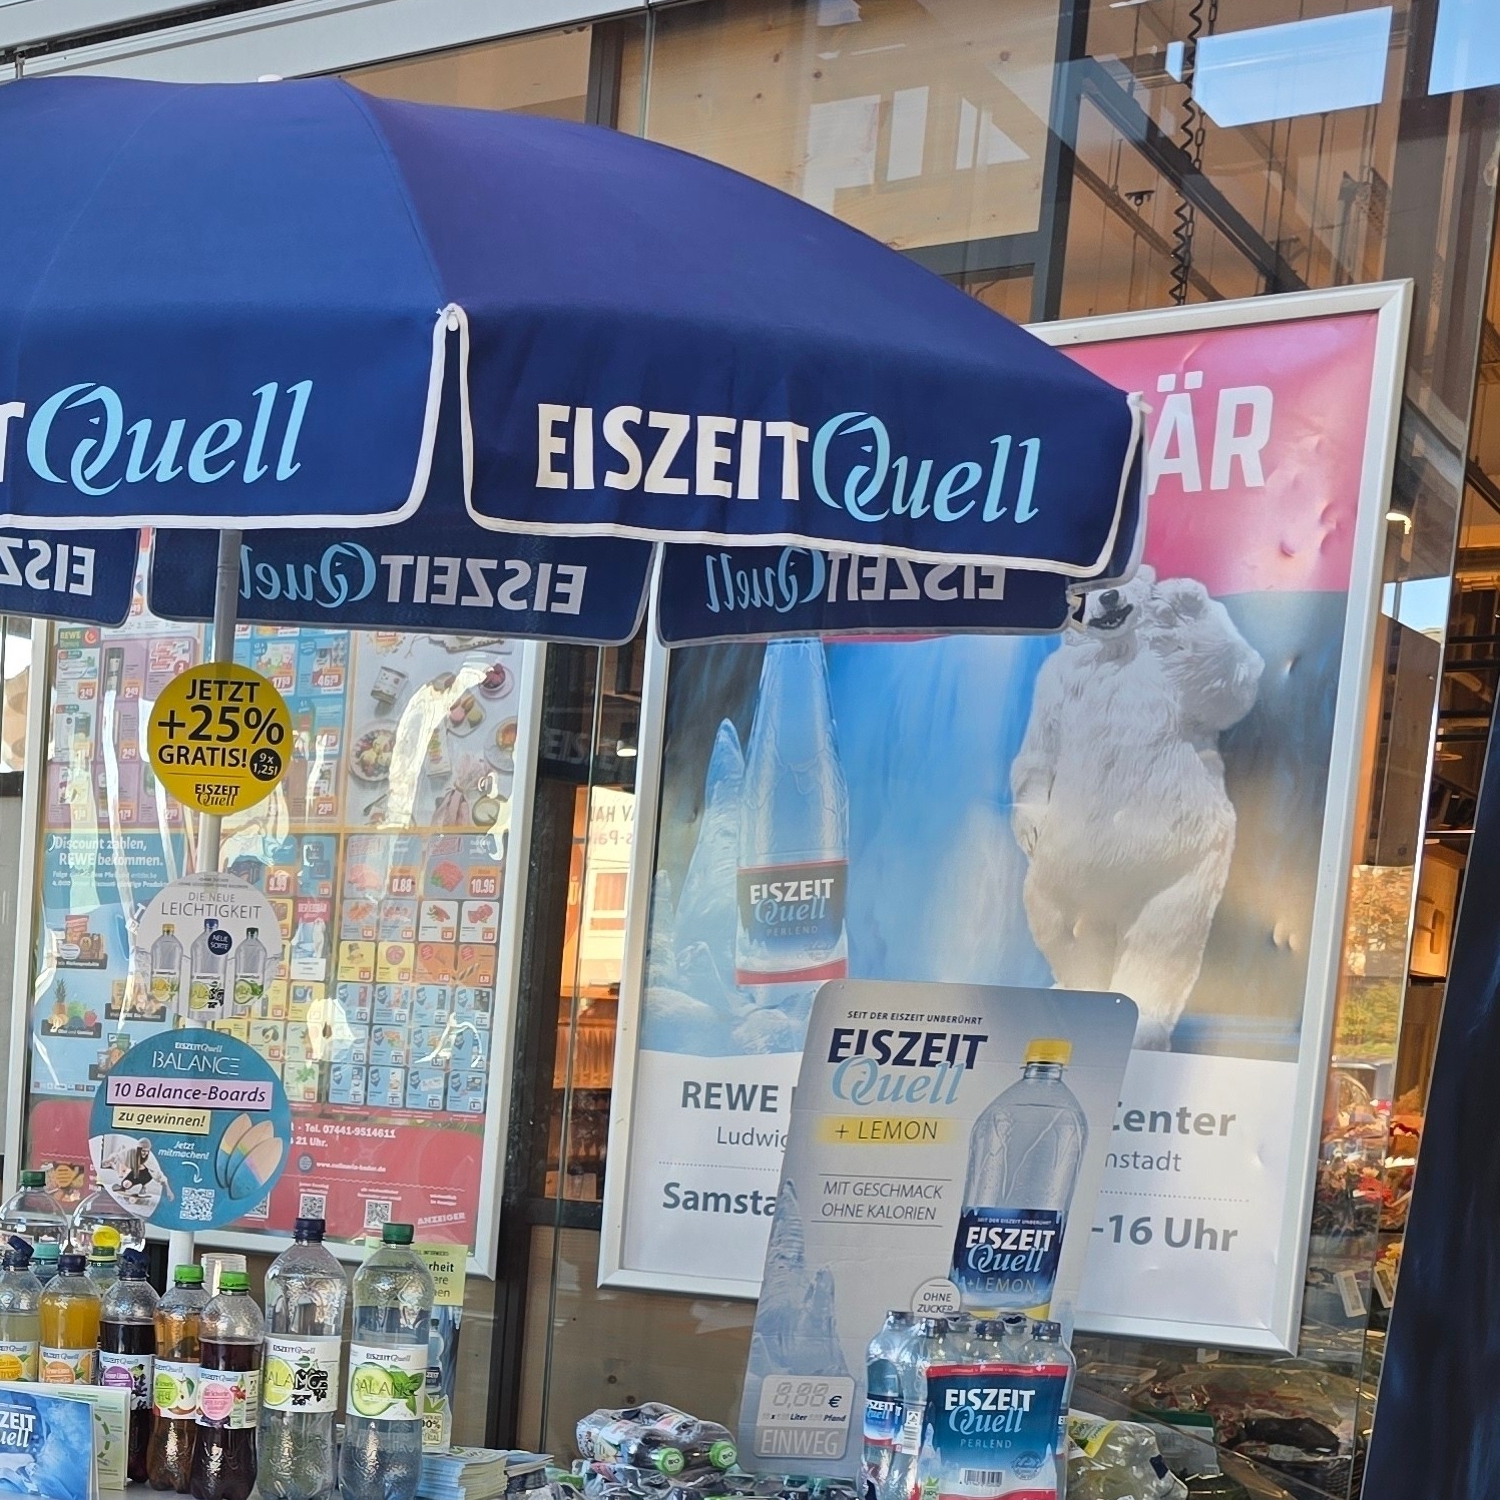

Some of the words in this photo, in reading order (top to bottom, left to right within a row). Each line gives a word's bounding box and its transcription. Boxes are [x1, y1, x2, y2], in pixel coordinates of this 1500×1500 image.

[536, 403, 1040, 524] EISZEITQuell
[186, 679, 260, 703] JETZT
[157, 704, 285, 746] +25%
[158, 745, 247, 769] GRATIS!
[195, 784, 240, 796] EISZEIT
[197, 792, 236, 806] Quell
[54, 836, 104, 850] Discount
[107, 837, 147, 851] zahlen,
[59, 852, 95, 866] REWE
[98, 852, 164, 867] bekommen.
[189, 892, 204, 900] DIE
[209, 893, 235, 902] NEUE
[749, 877, 835, 905] EISZEIT
[161, 902, 262, 919] LEICHTIGKEIT
[755, 894, 827, 925] Quell
[847, 1010, 868, 1020] SEIT
[870, 1012, 888, 1021] DER
[890, 1013, 925, 1023] EISZEIT
[926, 1013, 983, 1026] UNBERÜHRT
[827, 1028, 989, 1070] EISZEIT
[152, 1051, 241, 1076] BALANCE
[832, 1054, 967, 1107] Quell
[114, 1083, 131, 1097] 10
[135, 1083, 266, 1102] Balance-Boards
[681, 1081, 778, 1112] REWE
[118, 1112, 134, 1121] zu
[136, 1113, 206, 1127] gewinnen!
[305, 1123, 321, 1132] Tel.
[322, 1126, 396, 1139] 07441-9514611
[835, 1124, 850, 1140] +
[858, 1121, 938, 1140] LEMON
[174, 1141, 195, 1149] Jetzt
[296, 1136, 307, 1145] 21
[310, 1137, 328, 1147] Uhr.
[158, 1149, 209, 1160] mitmachen!
[824, 1181, 851, 1196] MIT
[852, 1182, 944, 1200] GESCHMACK
[417, 1212, 466, 1225] ANZEIGER
[821, 1203, 863, 1218] OHNE
[866, 1205, 937, 1221] KALORIEN
[966, 1226, 1056, 1252] EISZEIT
[1163, 1217, 1239, 1253] Uhr
[967, 1242, 1045, 1273] Quell
[923, 1292, 952, 1302] OHNE
[944, 1388, 1035, 1412] EISZEIT
[948, 1405, 1024, 1436] Quell
[760, 1429, 839, 1456] EINWEG
[960, 1438, 1012, 1449] PERLEND
